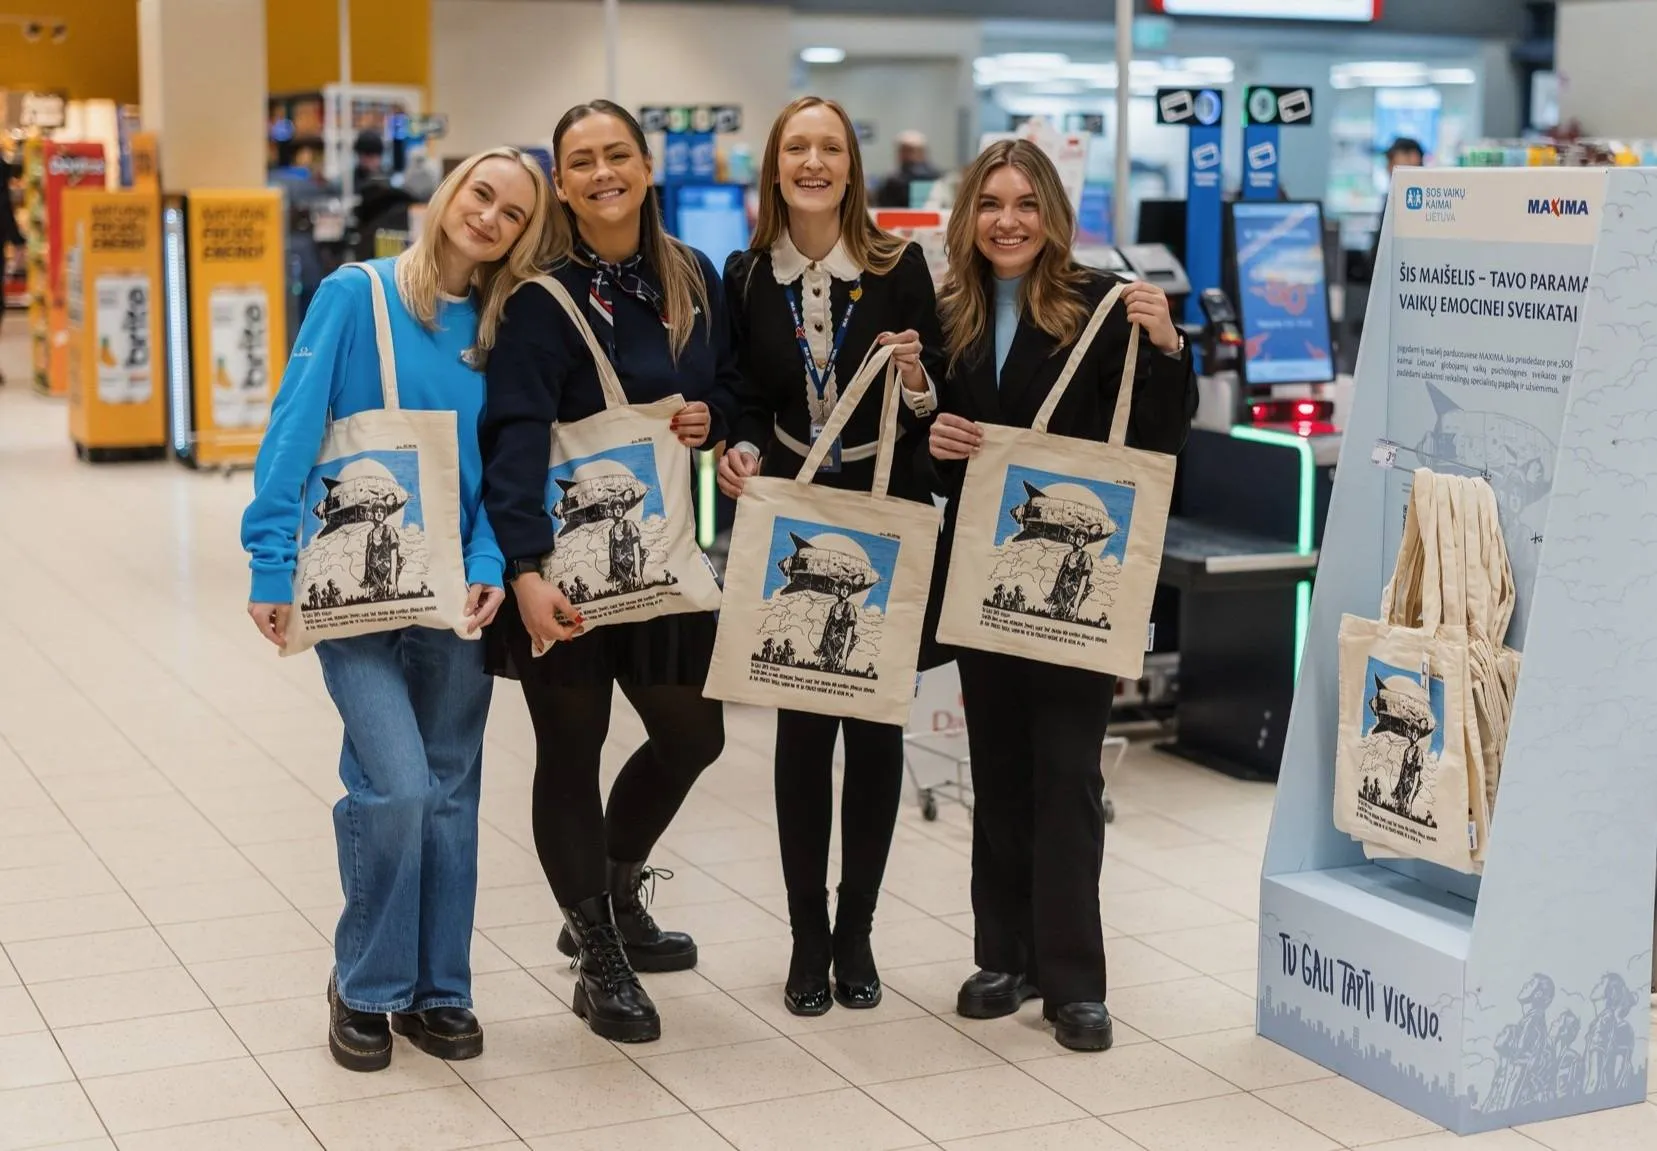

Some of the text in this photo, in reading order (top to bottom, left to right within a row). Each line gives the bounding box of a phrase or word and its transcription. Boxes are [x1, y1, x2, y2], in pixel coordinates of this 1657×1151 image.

[1426, 187, 1466, 200] SOS VAIKŲ
[1425, 199, 1452, 209] KAIMAI
[1527, 197, 1589, 217] MAXIMA
[1425, 211, 1456, 222] LIETUVA
[1400, 261, 1416, 282] ŠIS
[1419, 264, 1475, 286] MAIŠELIS
[1489, 271, 1526, 289] TAVO
[1400, 293, 1578, 323] VAIKŲ EMOCINEI SVEIKATAI
[1279, 932, 1442, 1042] TU GALI TAPTI VISKUO.
